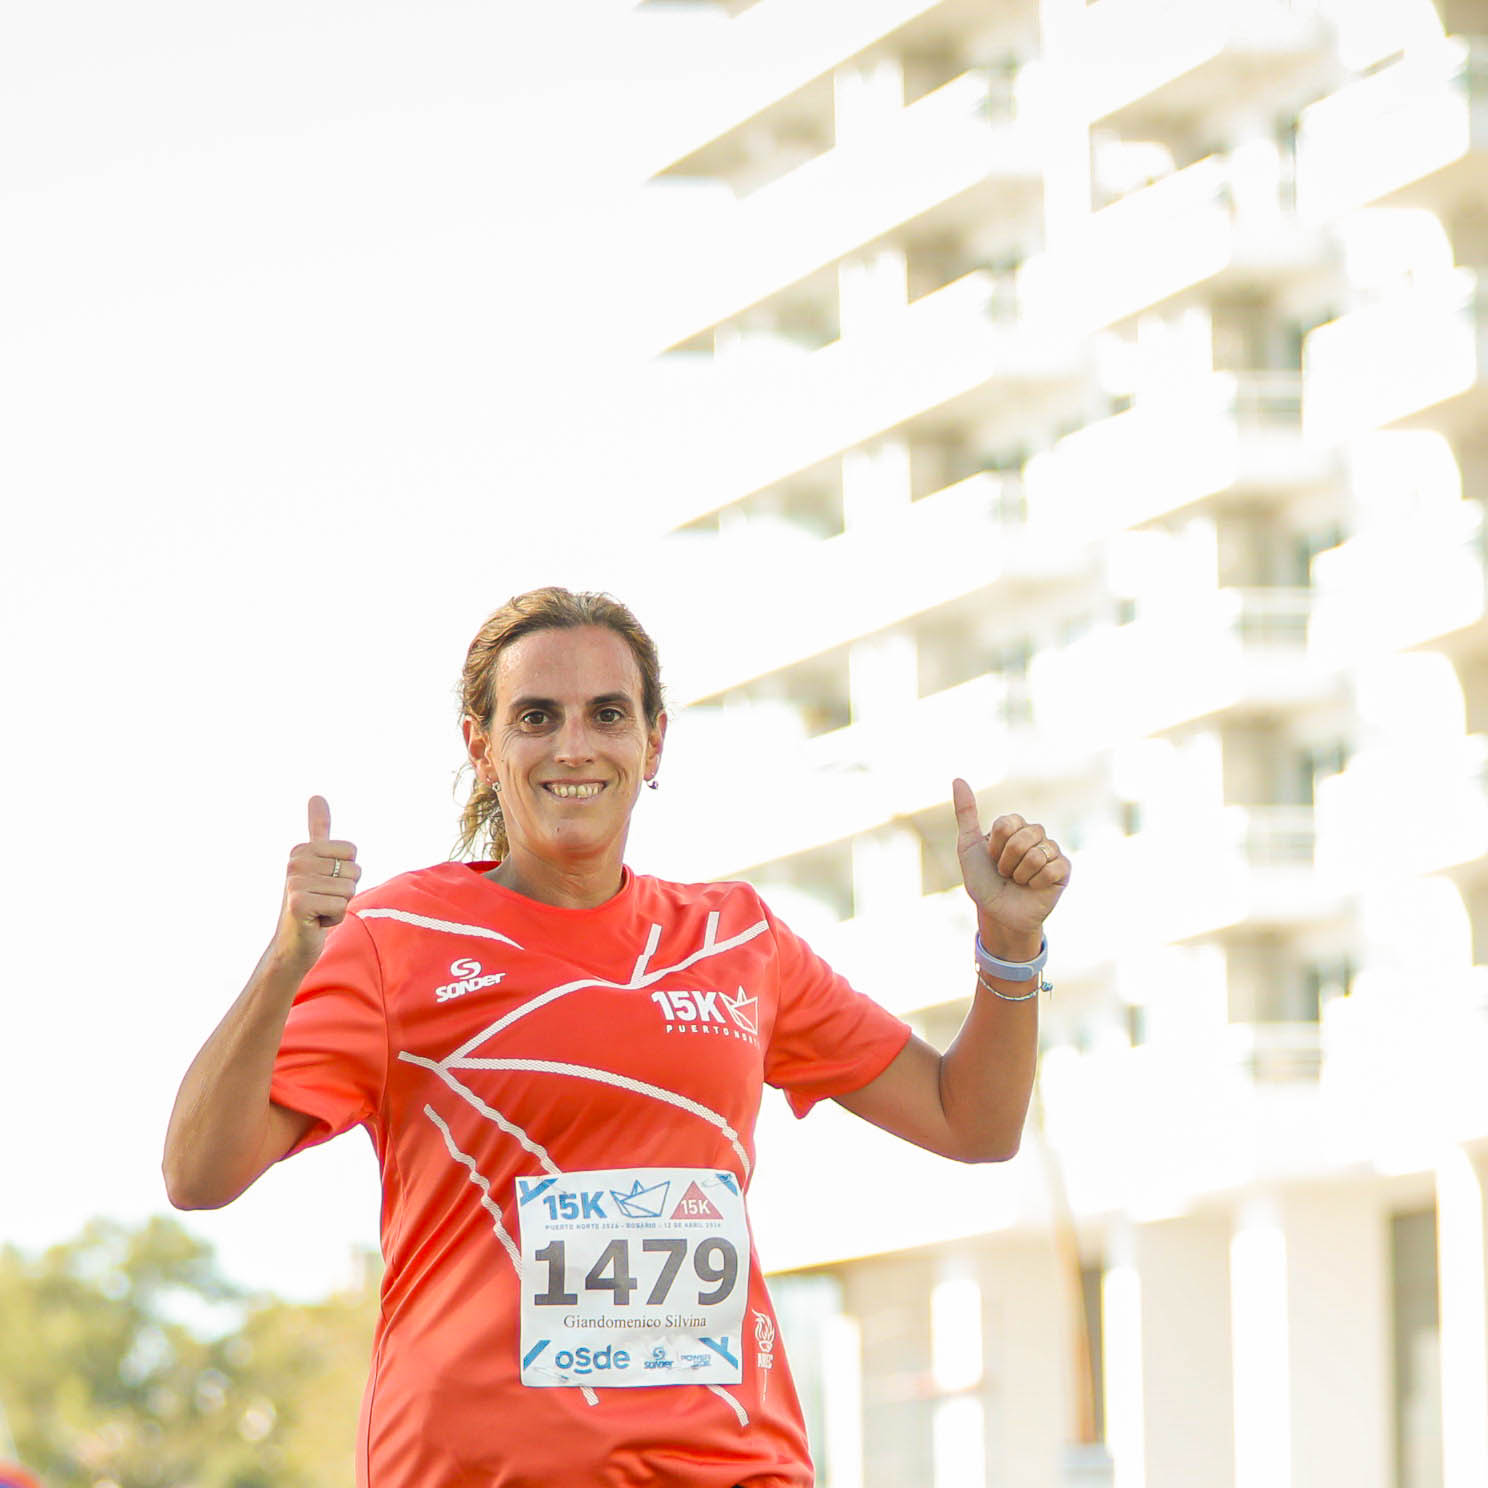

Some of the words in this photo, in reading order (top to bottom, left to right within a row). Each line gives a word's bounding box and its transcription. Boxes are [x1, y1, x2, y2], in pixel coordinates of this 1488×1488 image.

[650, 989, 728, 1024] 15K
[665, 1024, 730, 1037] PUERTO
[542, 1190, 609, 1221] 15K
[680, 1199, 712, 1215] 15K
[534, 1236, 739, 1306] 1479
[563, 1314, 662, 1329] Giandomenico
[664, 1313, 707, 1329] Silvina
[554, 1343, 631, 1372] osde
